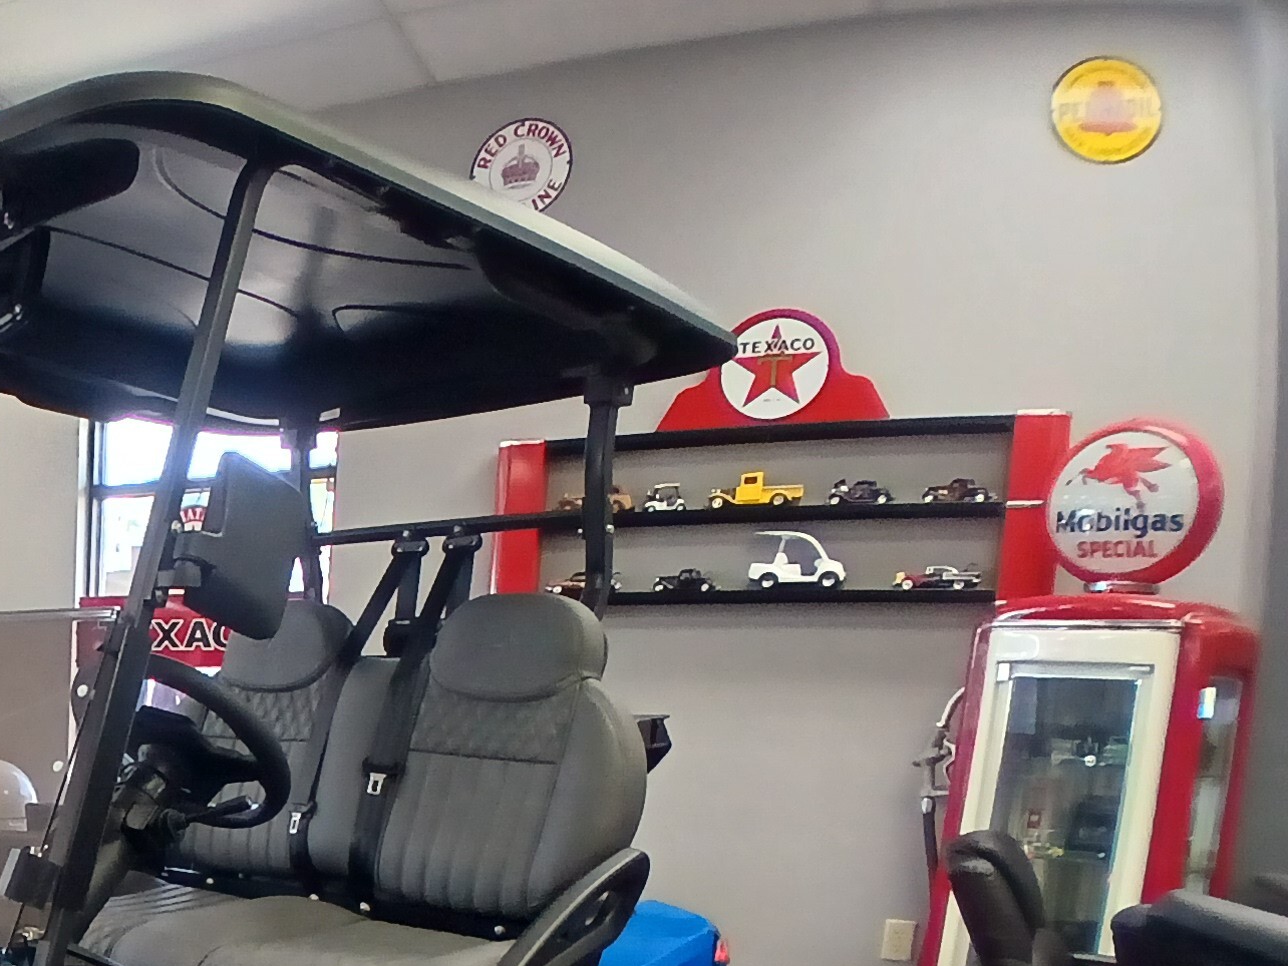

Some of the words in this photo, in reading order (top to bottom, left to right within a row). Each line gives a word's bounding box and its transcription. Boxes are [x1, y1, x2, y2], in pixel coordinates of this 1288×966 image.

[476, 133, 508, 170] RED
[513, 122, 568, 159] CROWN
[530, 178, 563, 212] INE
[738, 337, 816, 354] TEXACO
[1055, 507, 1185, 539] Mobilgas
[1076, 539, 1159, 559] SPECIAL
